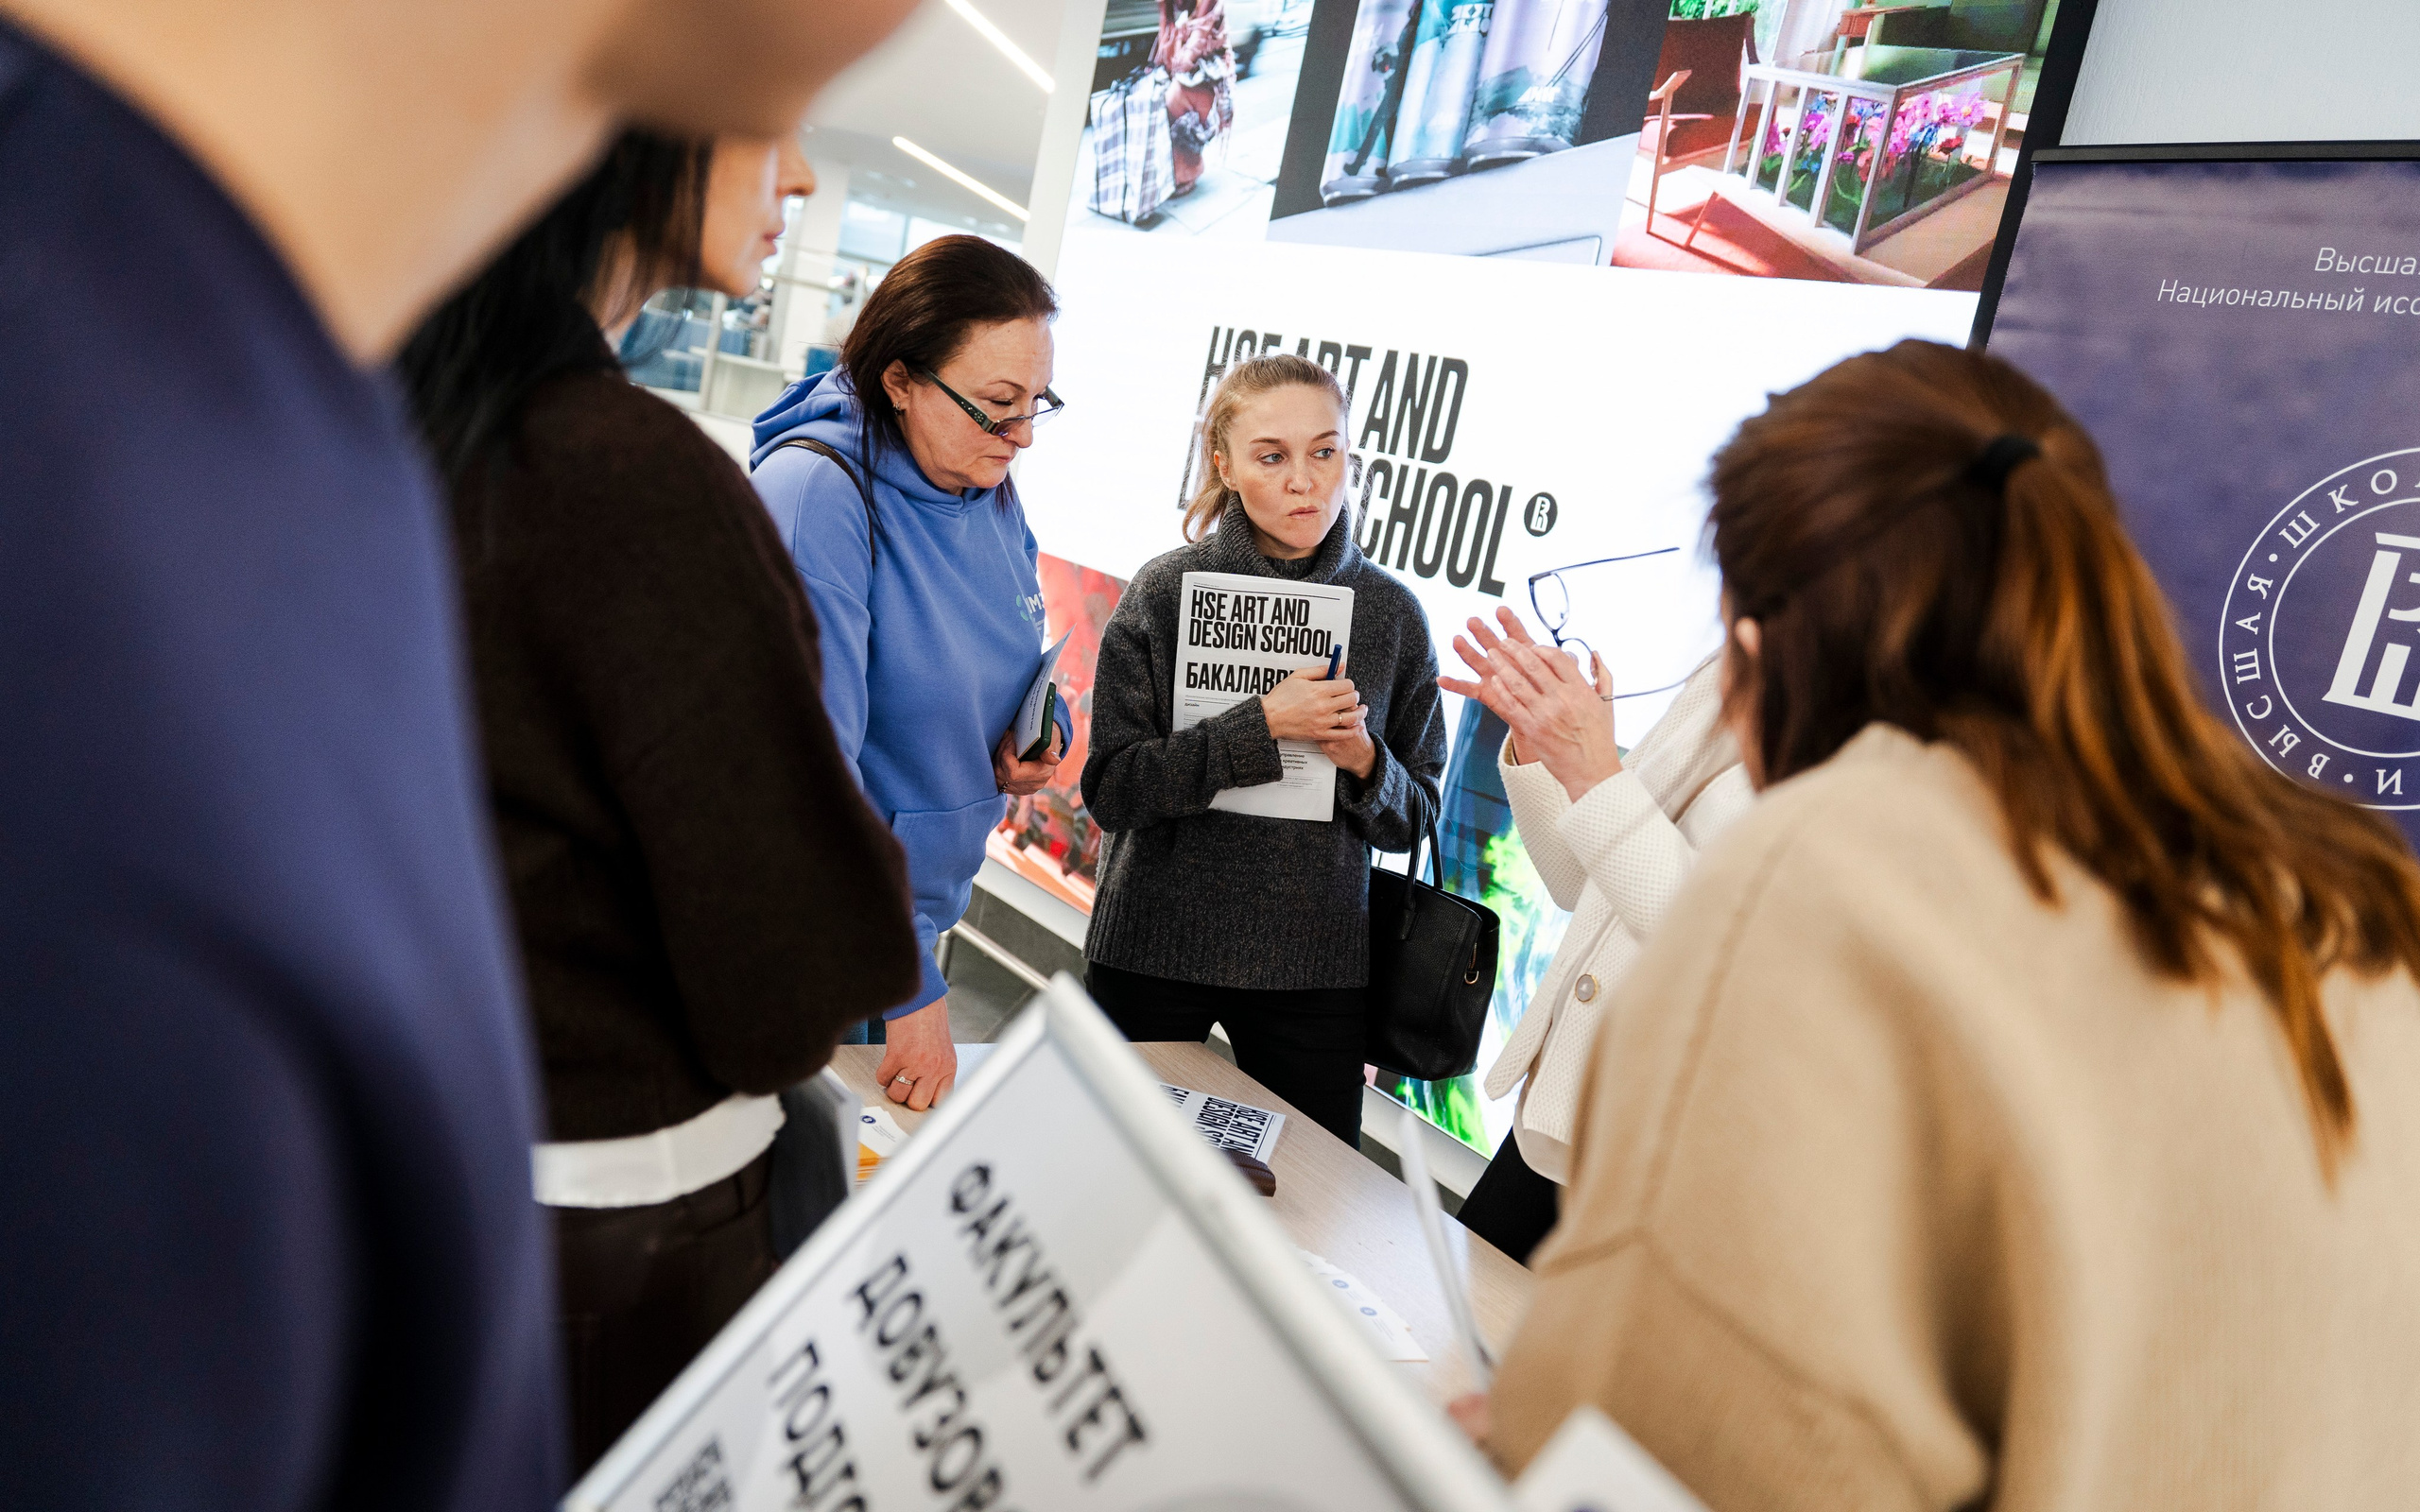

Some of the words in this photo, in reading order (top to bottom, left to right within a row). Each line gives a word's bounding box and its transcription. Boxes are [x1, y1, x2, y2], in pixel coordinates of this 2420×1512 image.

[2314, 247, 2420, 276] Высша
[2156, 279, 2365, 313] Национальный
[1358, 349, 1469, 464] AND
[2278, 469, 2420, 549] ШКО
[1191, 589, 1228, 621] HSE
[1230, 594, 1270, 624] ART
[1270, 597, 1310, 627] AND
[1188, 618, 1257, 651] DESIGN
[1260, 625, 1334, 659] SCHOOL
[1185, 662, 1295, 696] БАКАЛАВР
[2233, 573, 2331, 781] ВЫСШАЯ
[1227, 1120, 1263, 1144] ART
[1234, 1106, 1270, 1125] HSE
[949, 1163, 1147, 1481] ФАКУЛЬТЕТ
